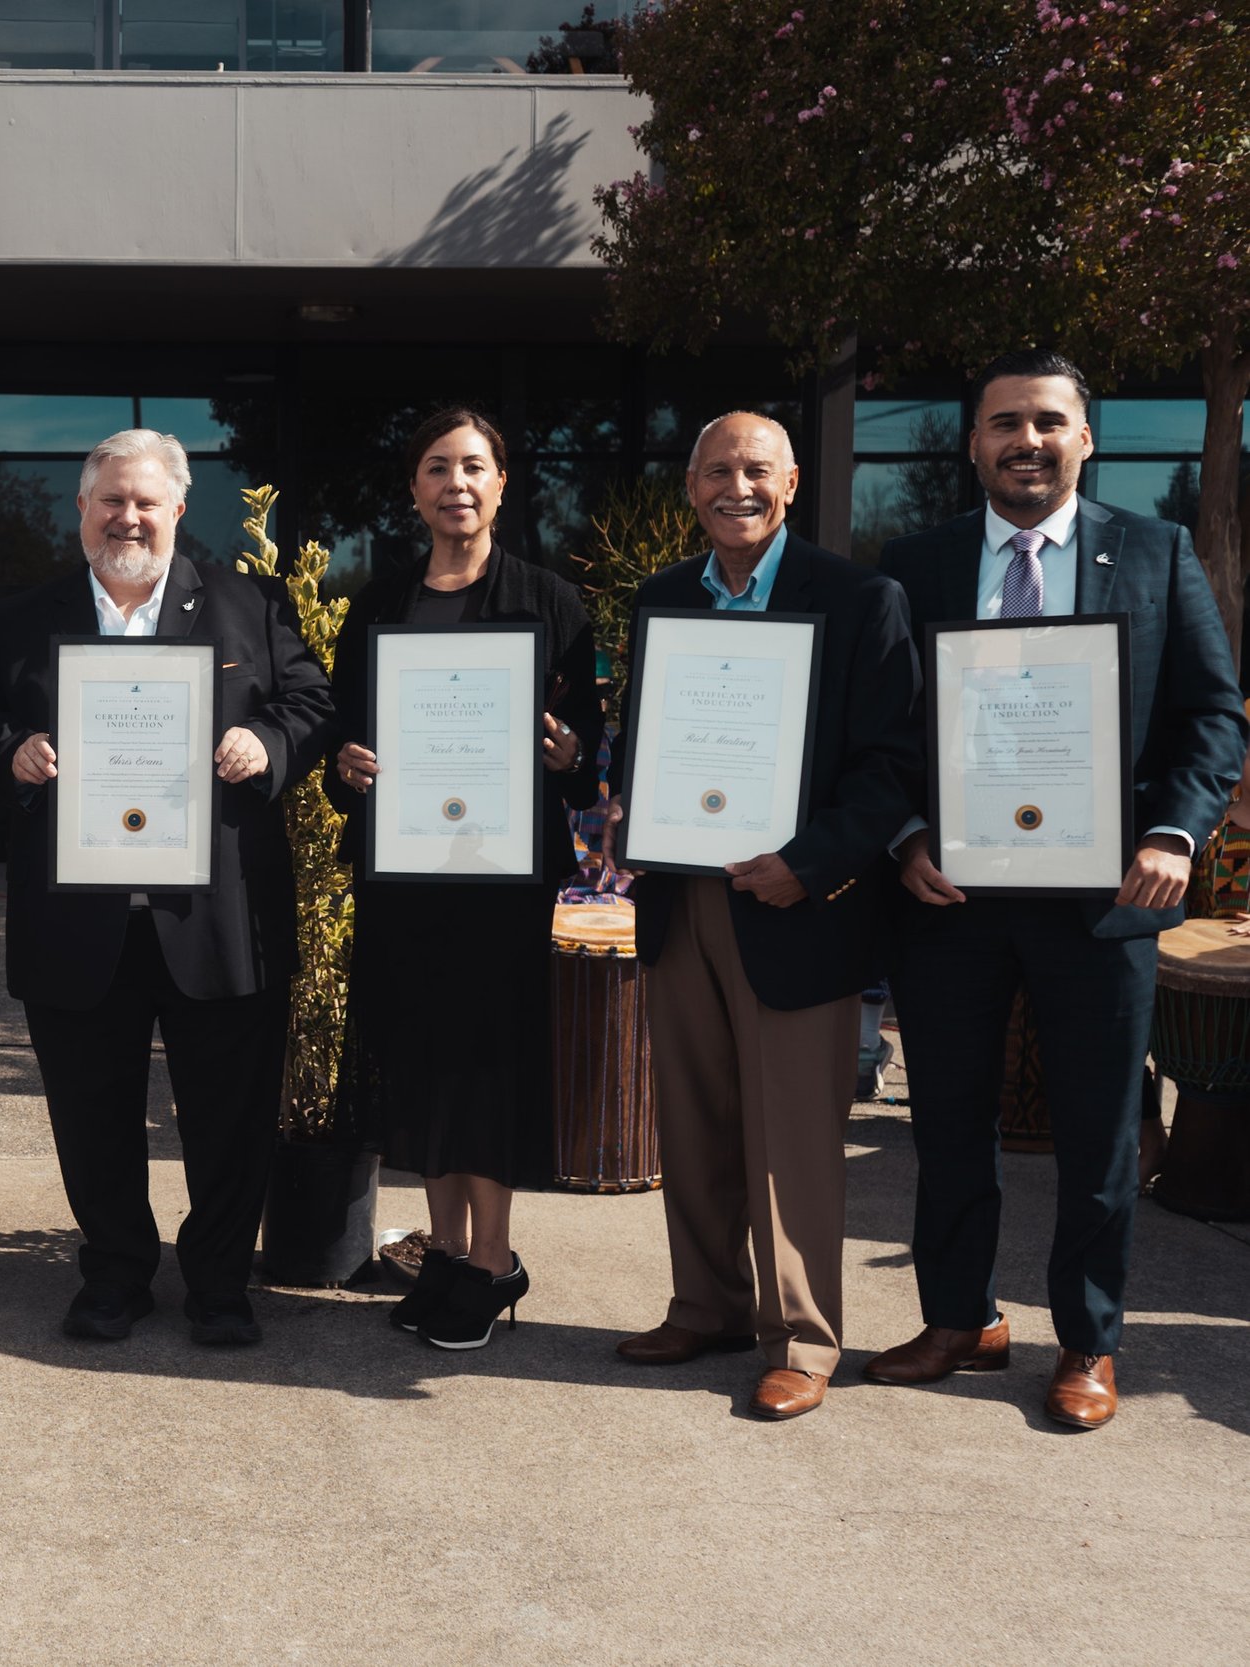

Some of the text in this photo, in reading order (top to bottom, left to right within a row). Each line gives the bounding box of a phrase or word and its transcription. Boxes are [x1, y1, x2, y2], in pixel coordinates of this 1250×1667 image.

[679, 689, 766, 701] CERTIFICATE OF
[413, 701, 495, 709] CERTIFICATE OF
[691, 698, 753, 708] INDUCTION
[978, 700, 1073, 711] CERTIFICATE OF
[94, 713, 175, 721] CERTIFICATE OF
[425, 709, 484, 717] INDUCTION
[991, 709, 1060, 718] INDUCTION
[106, 721, 164, 729] INDUCTION
[682, 732, 710, 744] Rick
[108, 754, 164, 766] Chris Evans
